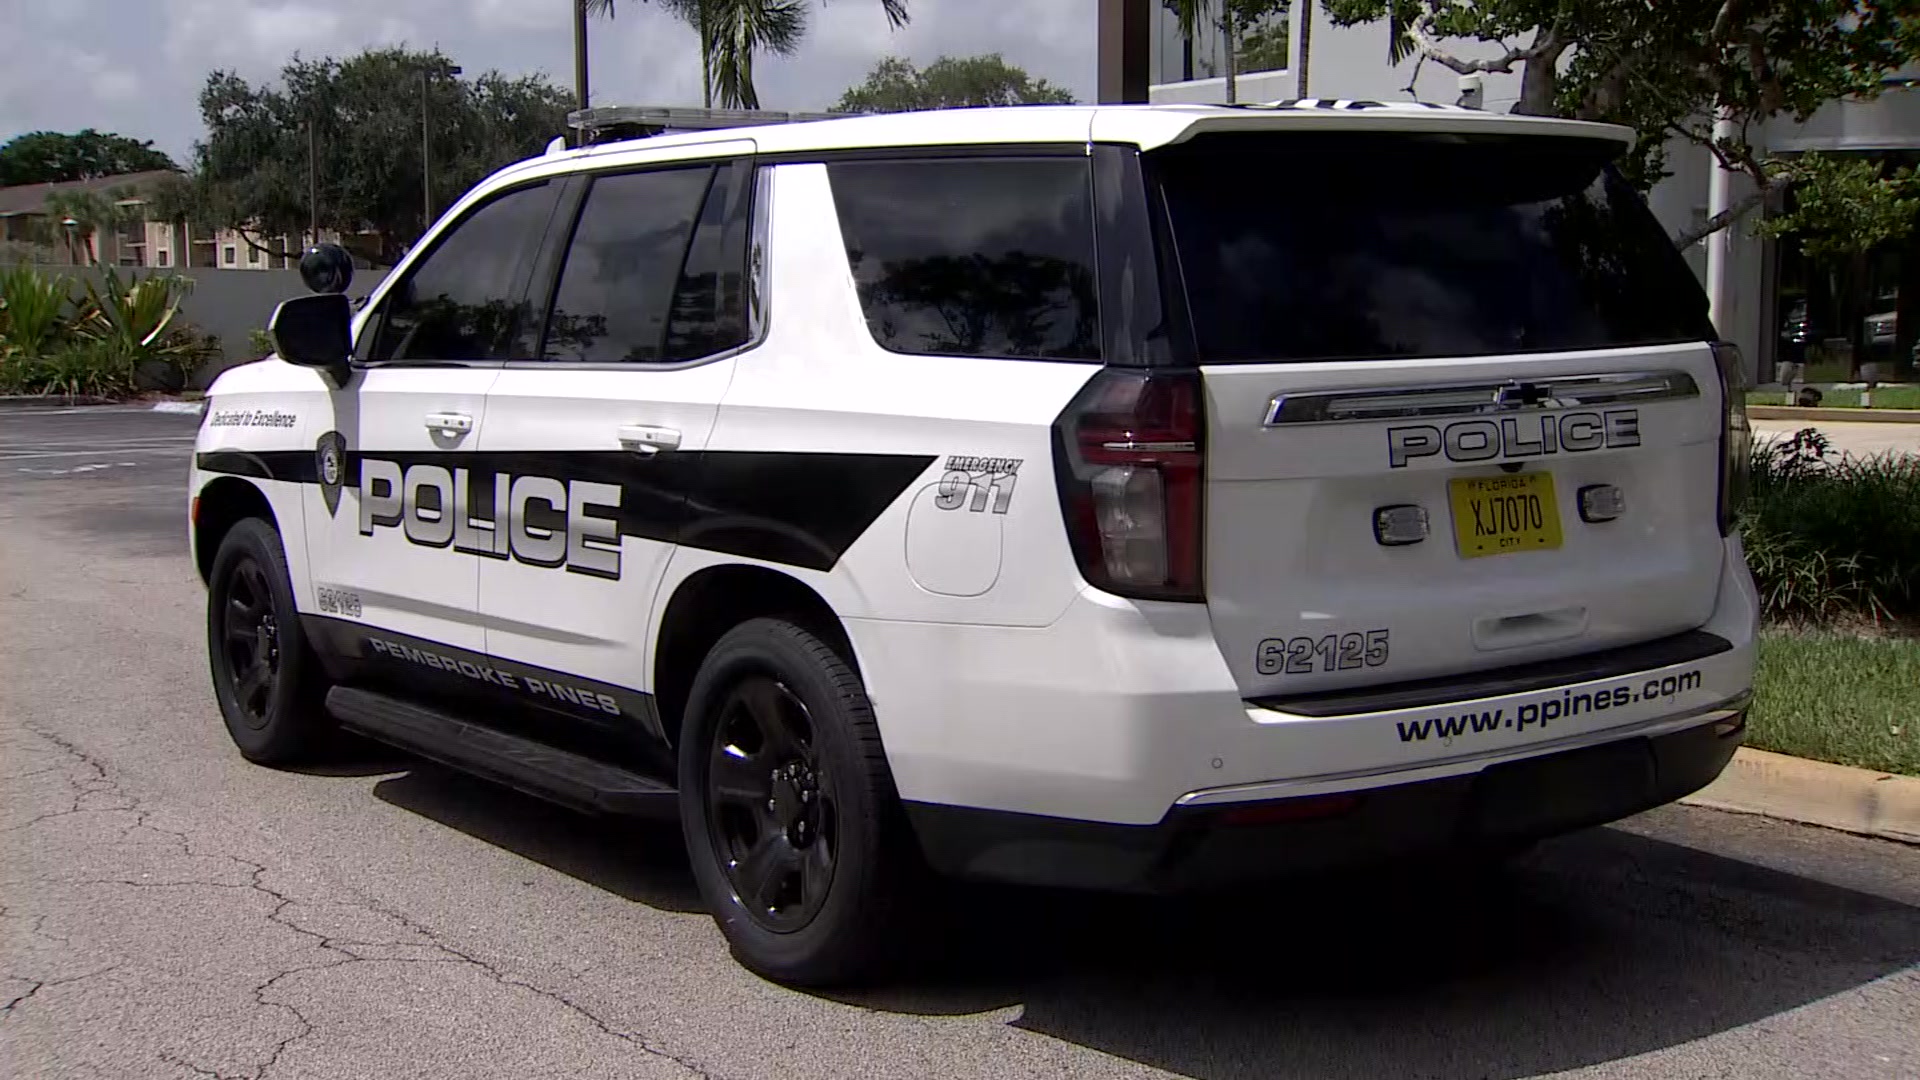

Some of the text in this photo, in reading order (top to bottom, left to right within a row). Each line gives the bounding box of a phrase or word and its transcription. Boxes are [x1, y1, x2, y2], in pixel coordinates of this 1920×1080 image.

[251, 410, 296, 428] Excellence
[1388, 409, 1641, 468] POLICE
[944, 455, 1024, 475] EMERGENCY
[1479, 478, 1526, 492] FLORIDA
[934, 470, 1018, 515] 911
[1470, 494, 1543, 536] XJ7070
[359, 458, 622, 581] POLICE
[1500, 537, 1521, 548] CITY
[1256, 629, 1389, 675] 62125
[368, 637, 622, 716] PEMBROKE PINES
[1396, 669, 1702, 742] www.ppines.com
